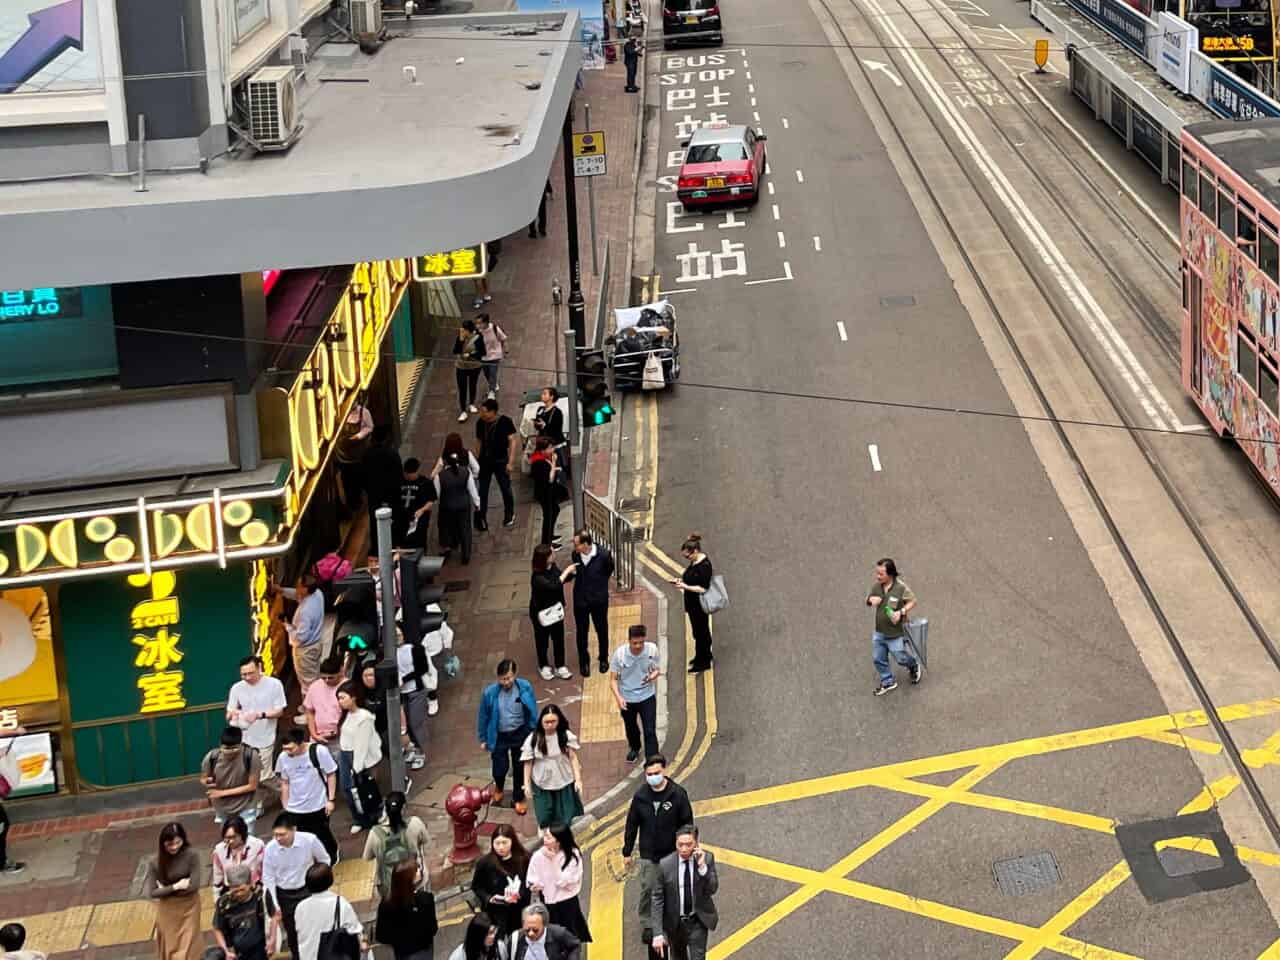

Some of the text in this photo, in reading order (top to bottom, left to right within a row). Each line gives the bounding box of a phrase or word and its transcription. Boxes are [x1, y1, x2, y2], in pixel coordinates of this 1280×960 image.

[666, 54, 727, 69] BUS
[660, 69, 736, 85] STOP
[666, 86, 731, 111] 巴士
[675, 239, 748, 282] 站
[131, 627, 186, 713] 冰室
